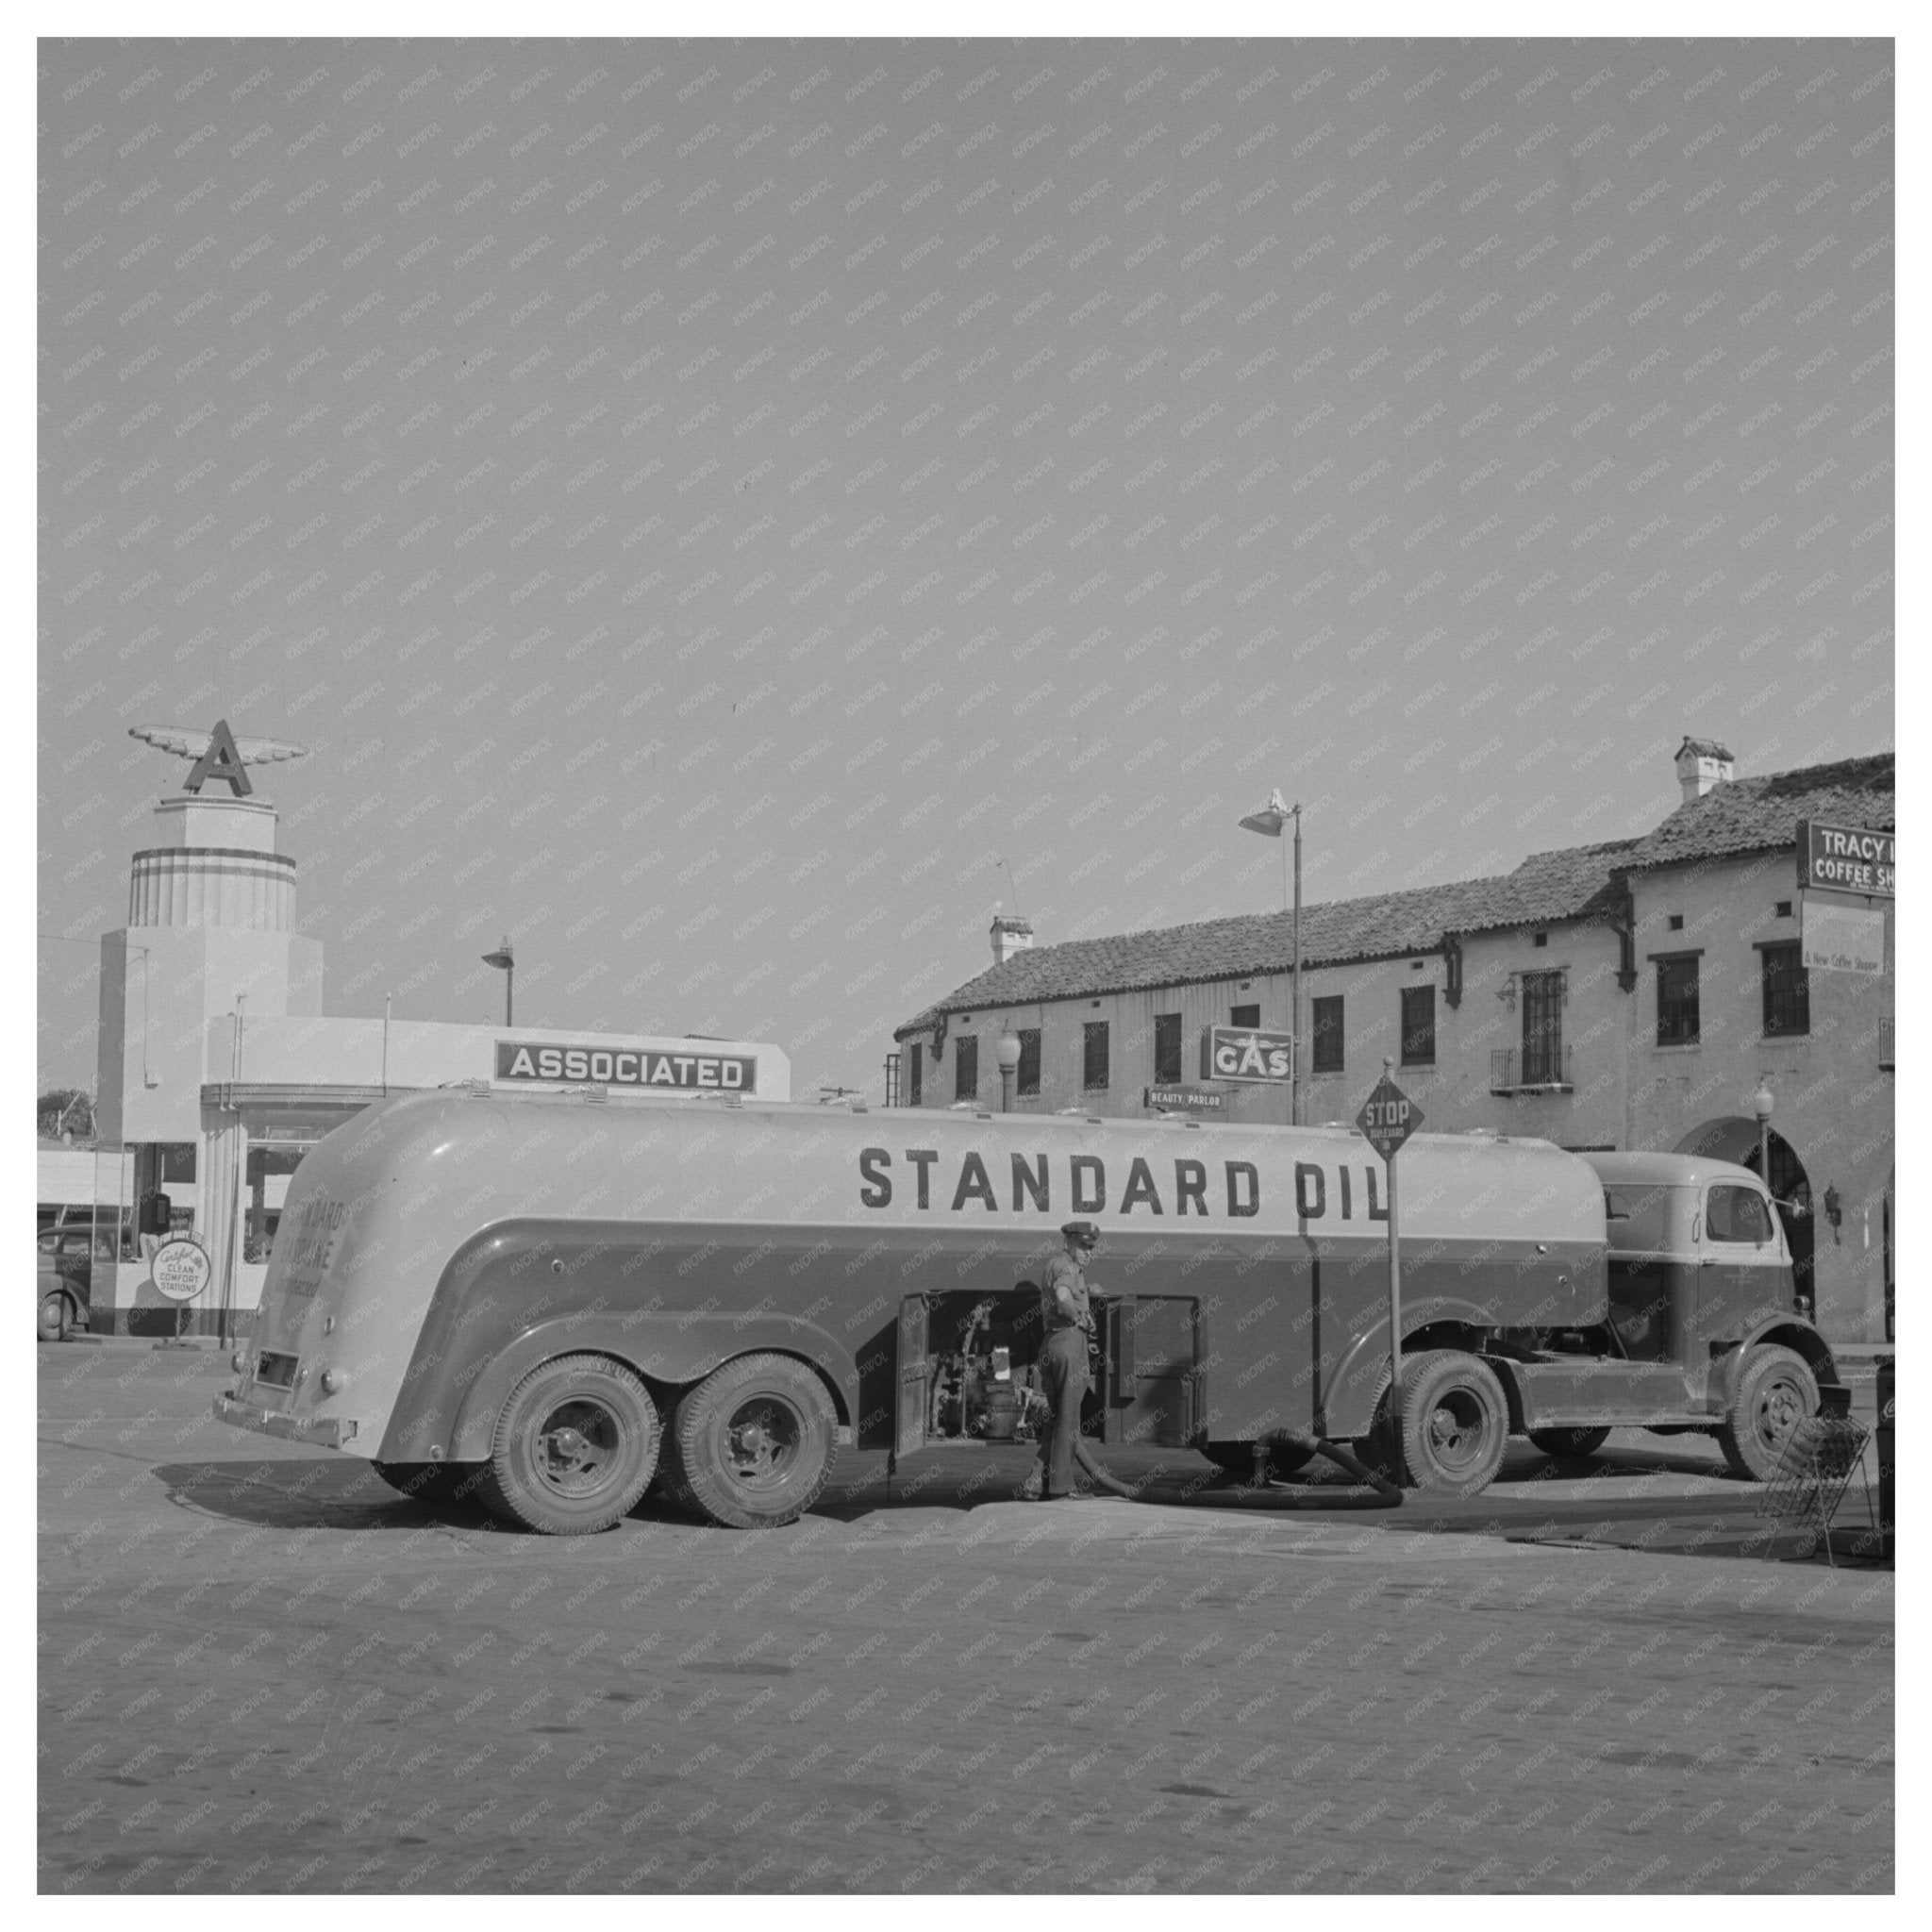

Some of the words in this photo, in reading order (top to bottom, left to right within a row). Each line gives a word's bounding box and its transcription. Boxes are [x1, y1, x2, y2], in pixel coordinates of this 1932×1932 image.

[182, 719, 253, 797] A
[1822, 830, 1886, 860] TRACY
[1816, 858, 1872, 884] COFFEE
[1813, 951, 1828, 966] New
[1831, 954, 1852, 968] Coffee
[509, 1048, 742, 1087] ASSOCIATED
[1216, 1034, 1290, 1077] GAS
[1151, 1092, 1183, 1104] BEAUTY
[1188, 1094, 1221, 1106] PARLOR
[1366, 1100, 1409, 1126] STOP
[858, 1147, 1260, 1218] STANDARD
[1296, 1161, 1391, 1222] OIL
[159, 1273, 199, 1283] COMFORT
[167, 1264, 193, 1274] CLEAN
[160, 1282, 196, 1292] STATIONS
